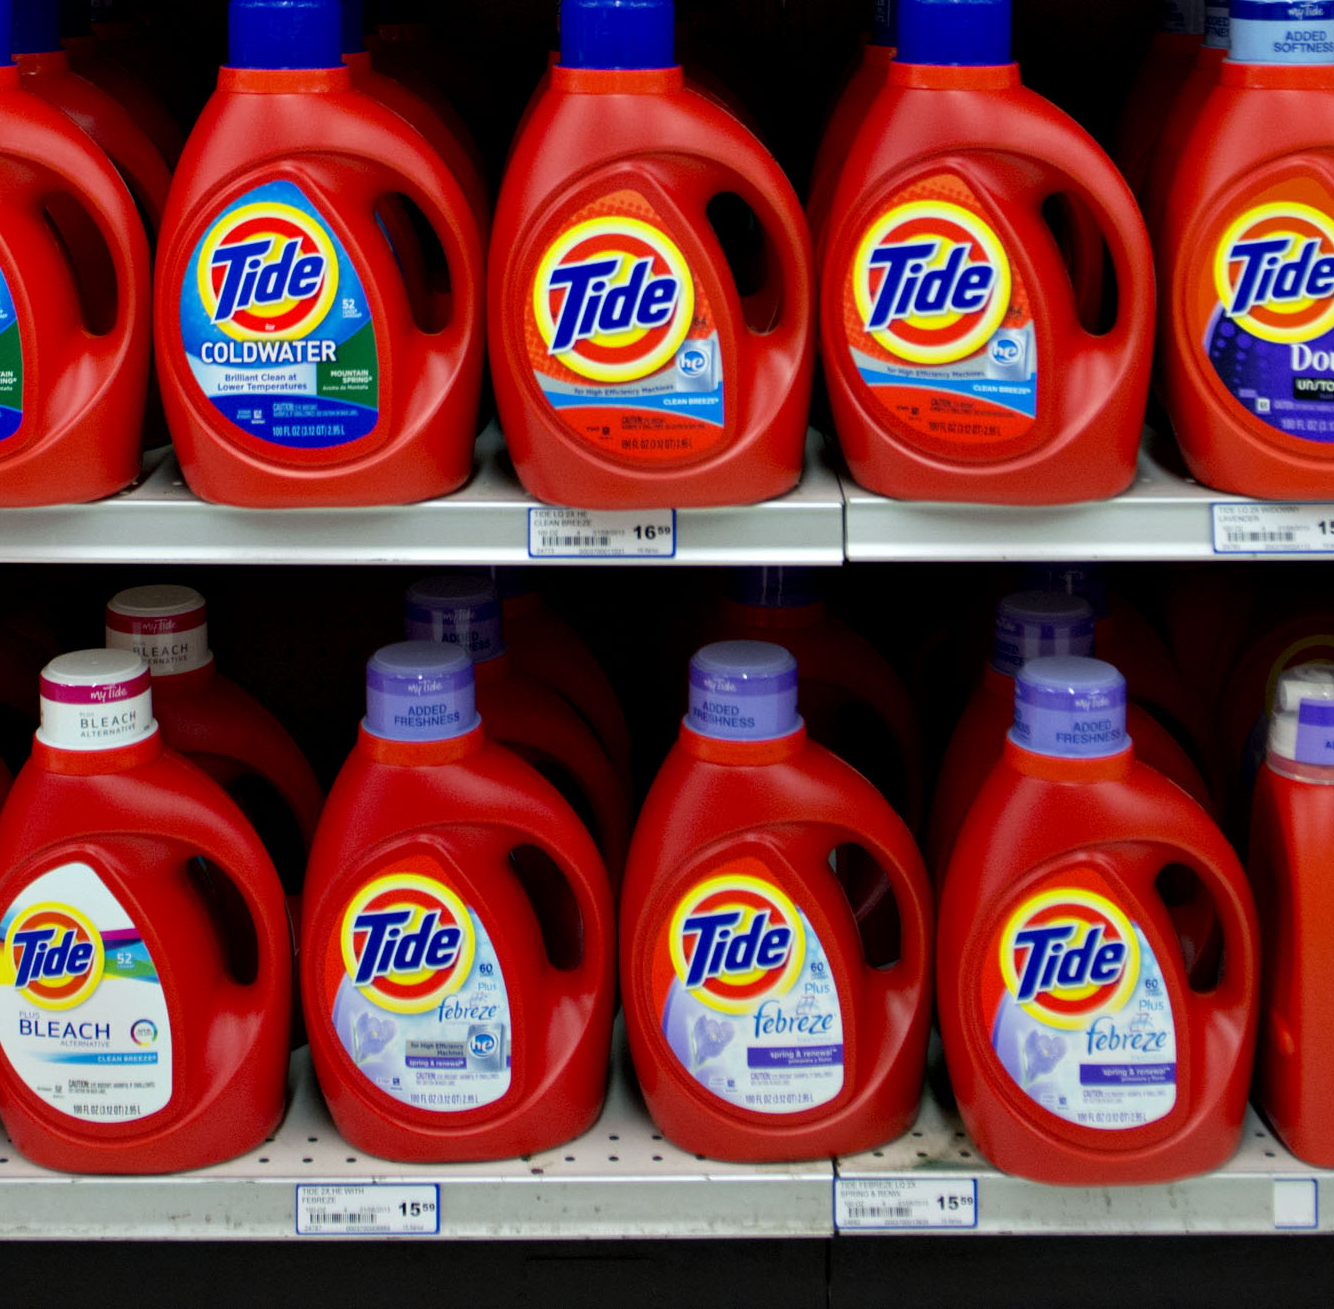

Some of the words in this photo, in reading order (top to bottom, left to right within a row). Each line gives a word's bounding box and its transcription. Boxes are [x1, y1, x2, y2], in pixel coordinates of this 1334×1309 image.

[1284, 30, 1327, 43] ADDED
[1273, 40, 1334, 54] SOFTNESS
[210, 236, 326, 324] Tide
[864, 243, 994, 333] Tide
[342, 299, 355, 310] 52
[547, 256, 678, 354] Tide
[201, 340, 336, 363] COLDWATER
[218, 381, 243, 391] Lower
[245, 382, 307, 392] Temperatures
[224, 373, 259, 382] Brilliant
[261, 373, 283, 382] Clean
[80, 709, 137, 731] BLEACH
[394, 714, 460, 728] FRESHNESS
[406, 705, 447, 718] ADDED
[1073, 719, 1111, 735] ADDED
[353, 910, 461, 986] Tide
[682, 909, 793, 989] Tide
[12, 928, 95, 989] Tide
[117, 953, 132, 966] 52
[1014, 924, 1127, 1004] Tide
[804, 982, 830, 994] Plus
[438, 996, 498, 1023] febreze
[1139, 998, 1164, 1011] Plus
[753, 1000, 834, 1039] febreze
[19, 1020, 111, 1040] BLEACH
[1085, 1016, 1167, 1056] febreze
[97, 1054, 123, 1062] CLEAN
